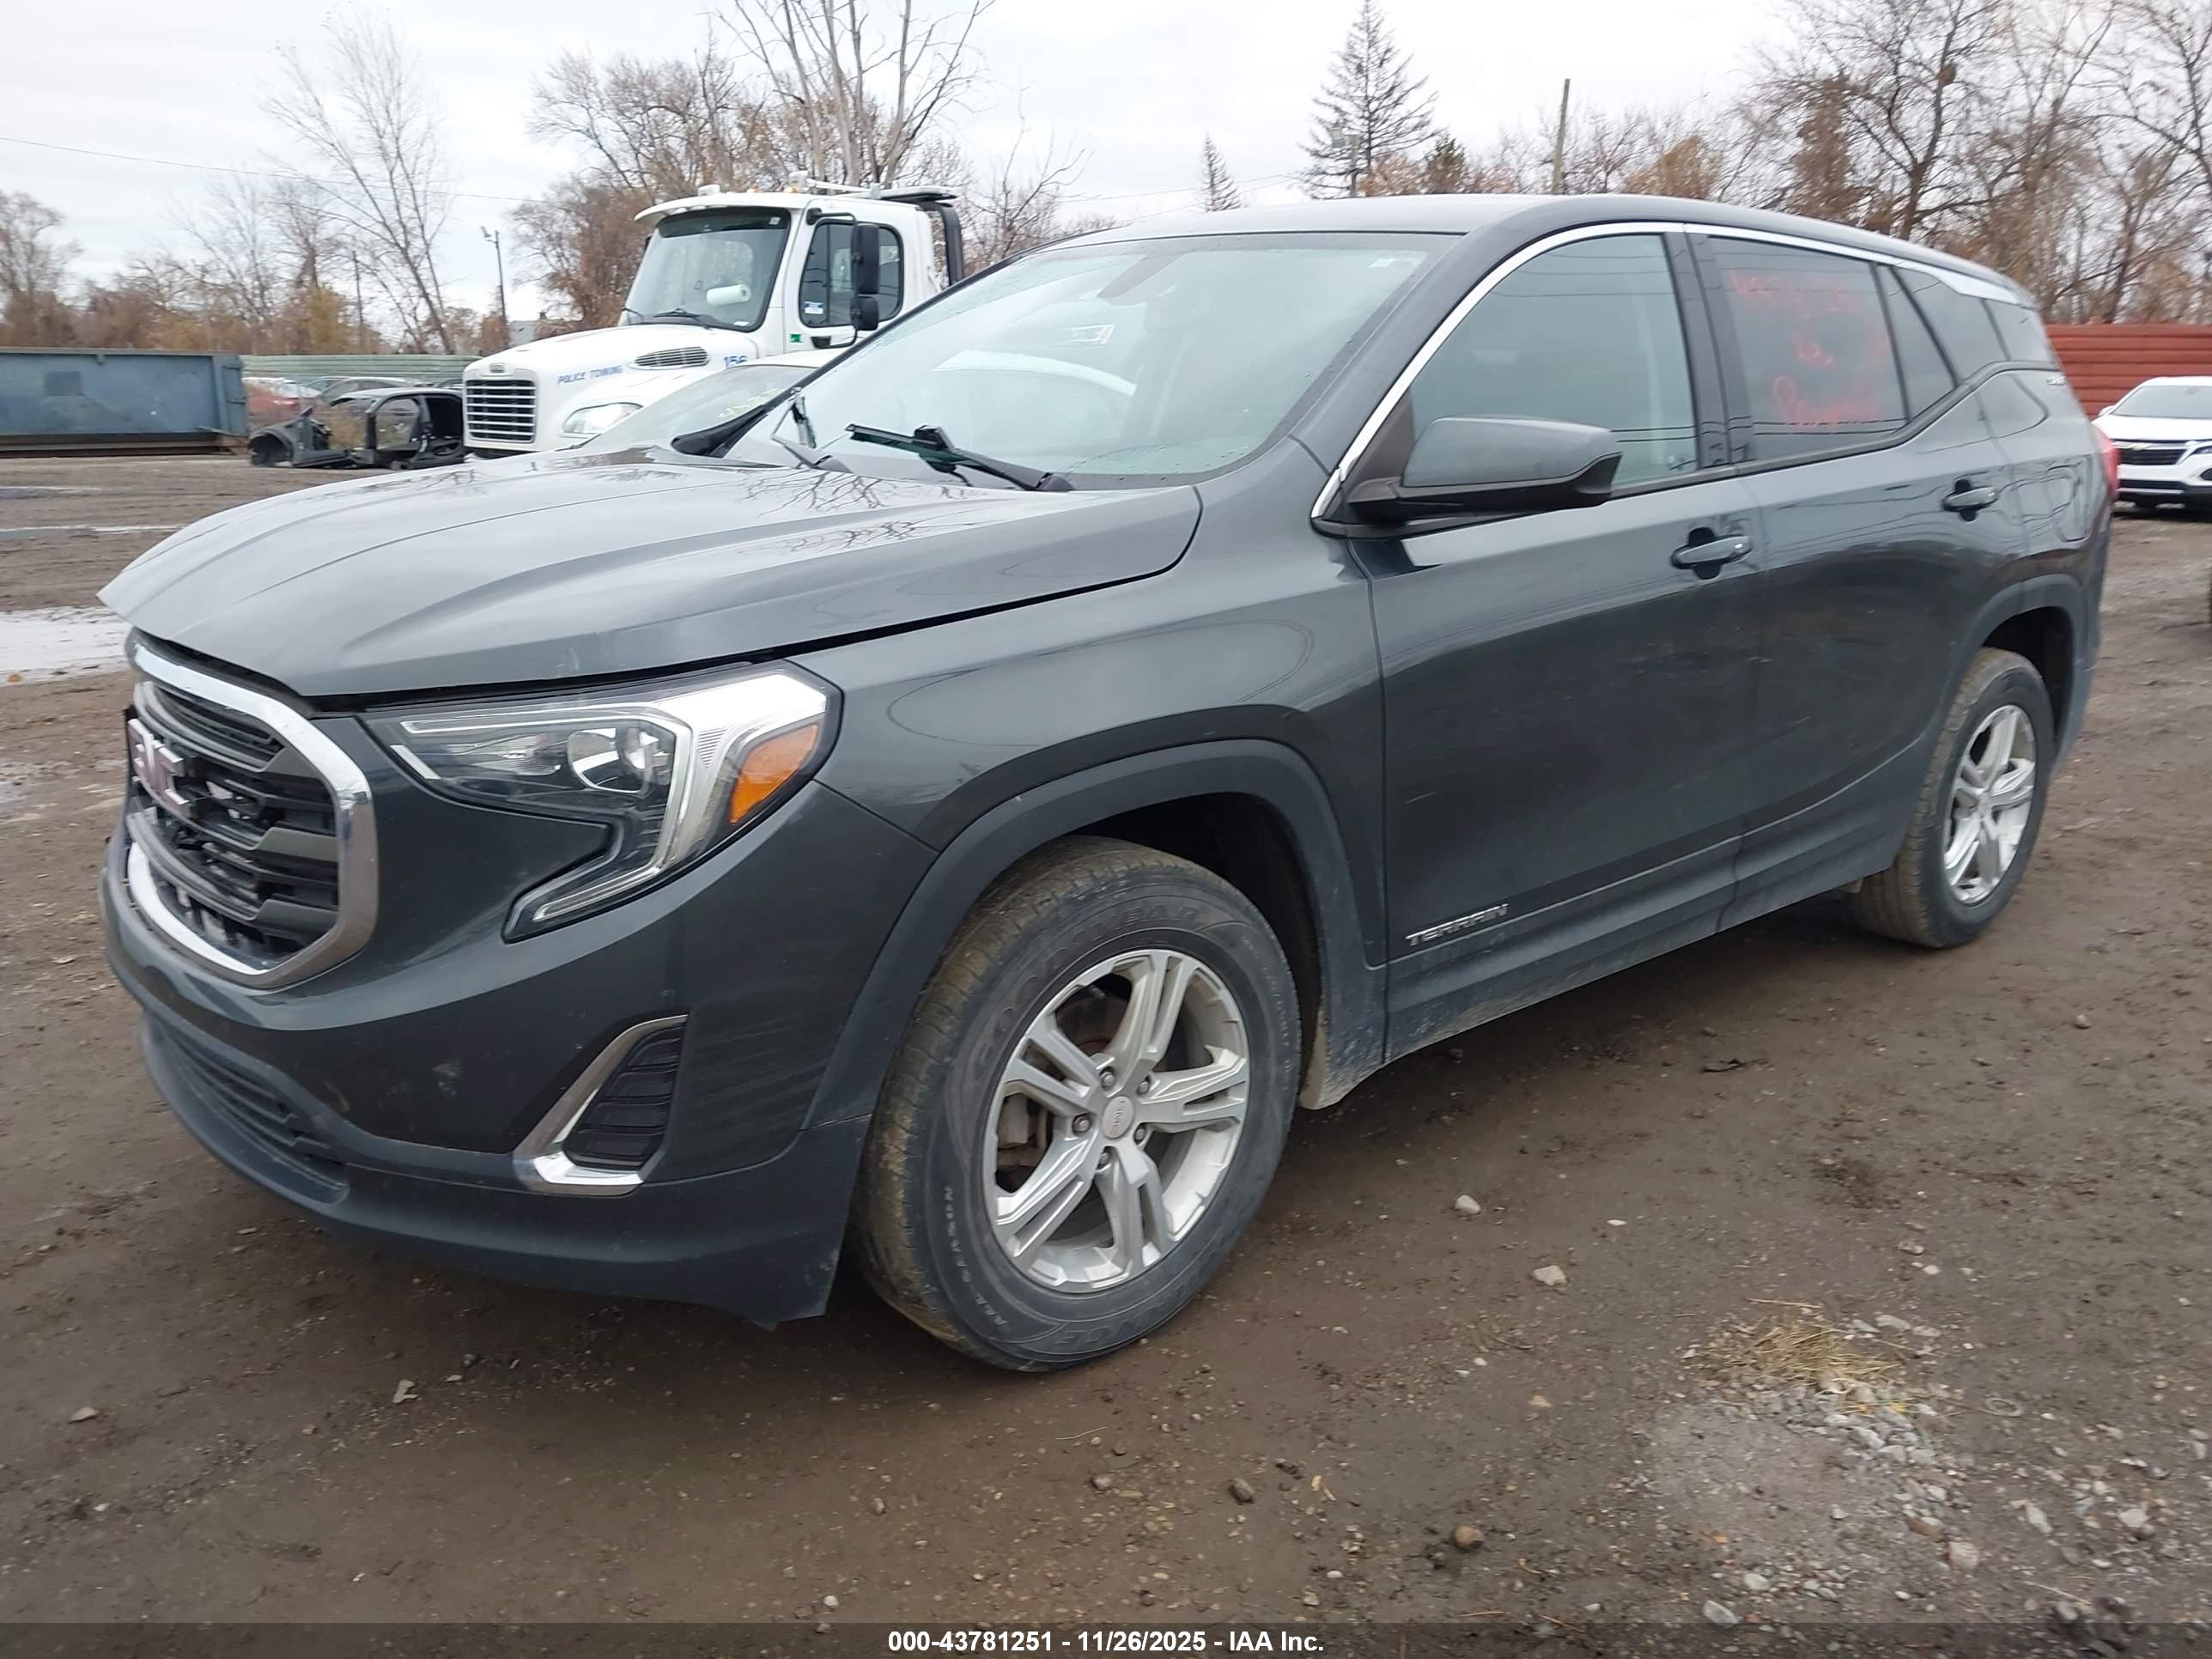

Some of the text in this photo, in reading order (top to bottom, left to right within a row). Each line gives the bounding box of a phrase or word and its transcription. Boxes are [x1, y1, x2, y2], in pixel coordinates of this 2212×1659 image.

[556, 365, 623, 385] POLICE TOWING
[1404, 902, 1510, 947] TERRAIN
